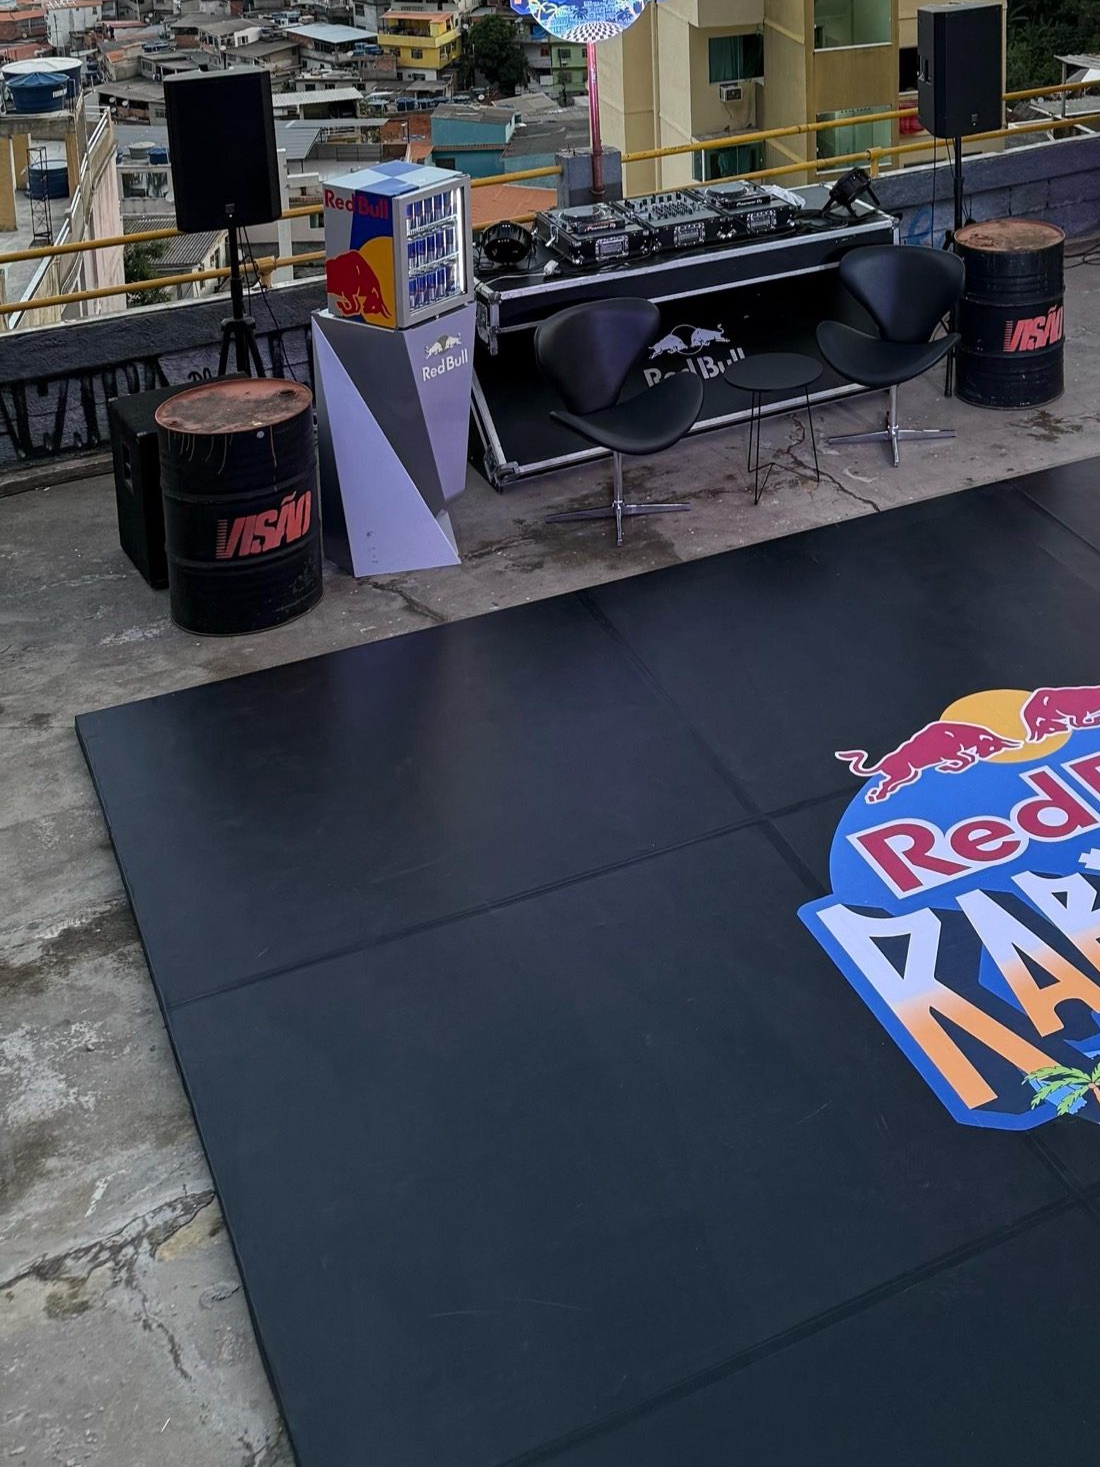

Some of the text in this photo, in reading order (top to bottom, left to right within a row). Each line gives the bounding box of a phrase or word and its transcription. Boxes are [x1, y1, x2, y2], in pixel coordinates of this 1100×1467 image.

[324, 189, 388, 220] Red Bull
[422, 348, 468, 382] Red Bull
